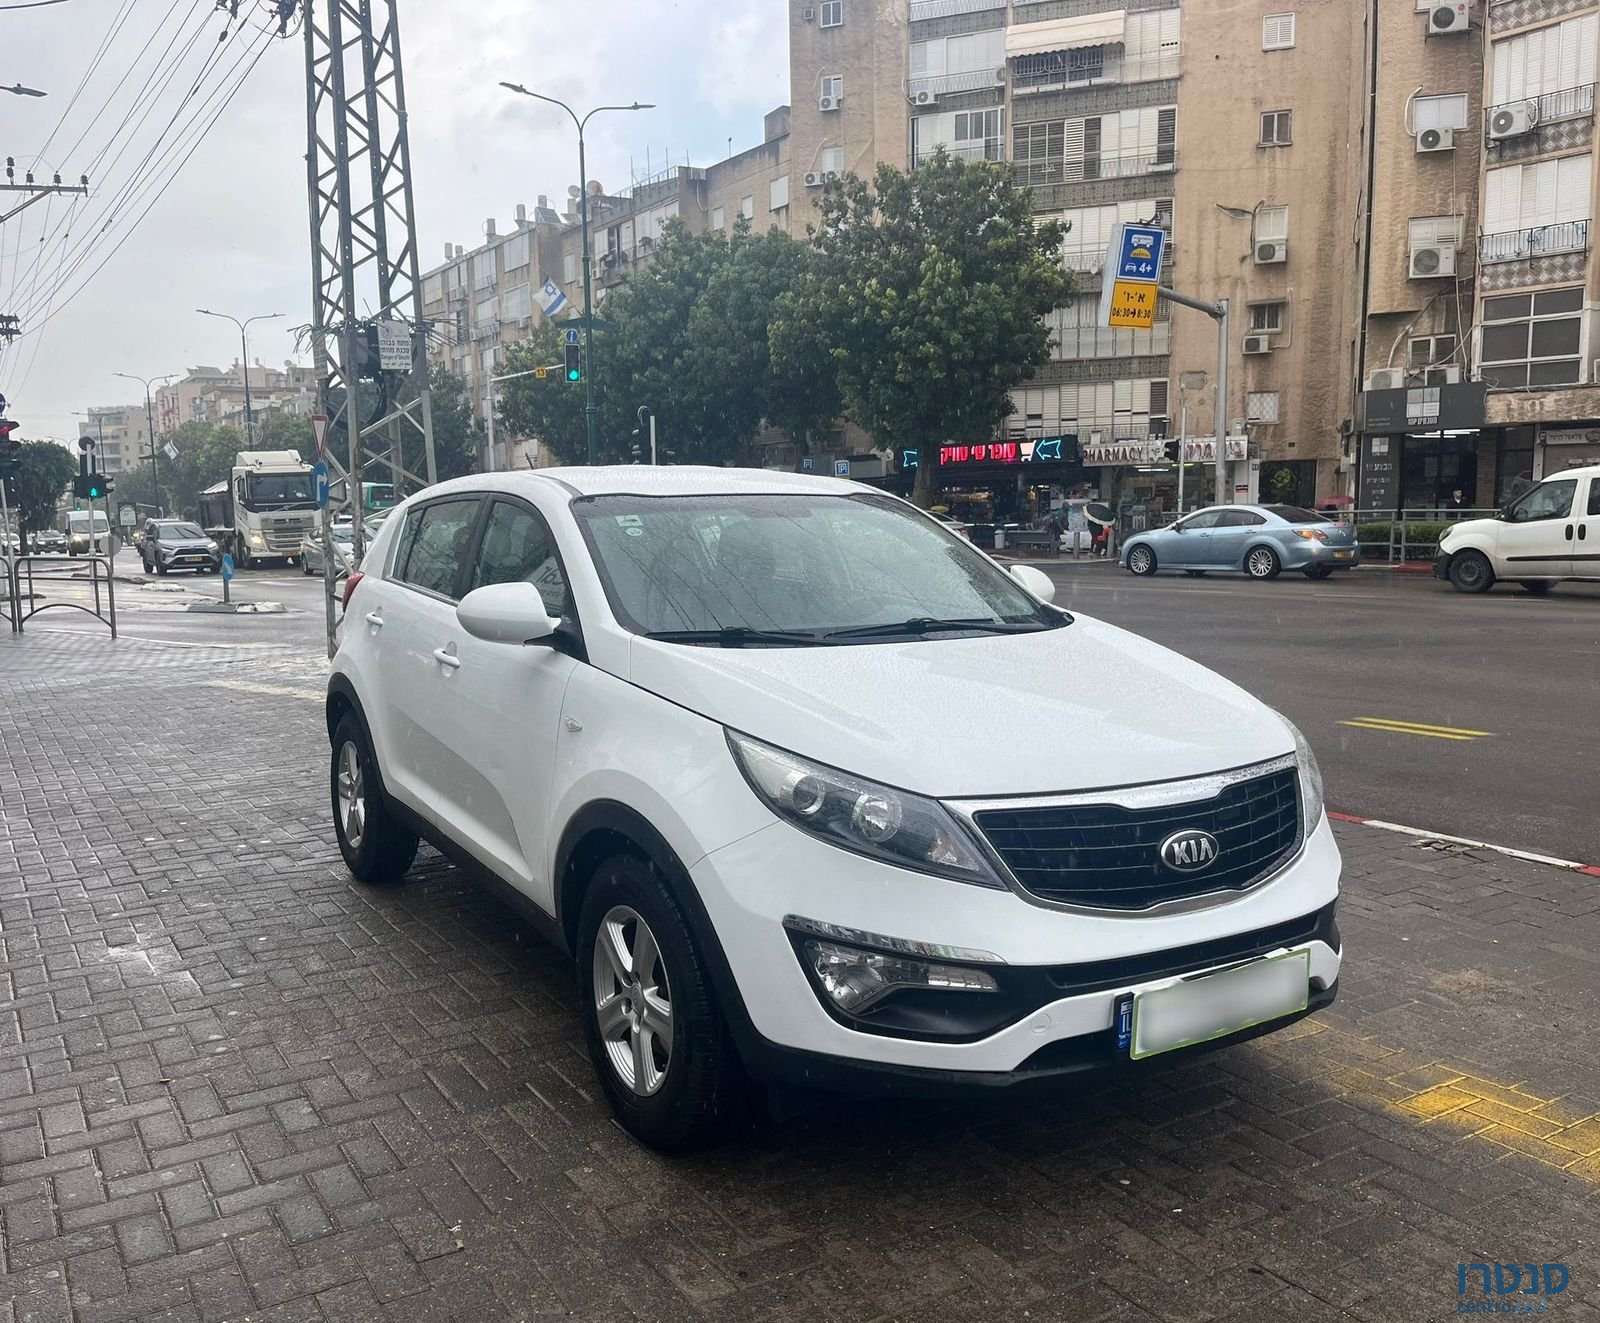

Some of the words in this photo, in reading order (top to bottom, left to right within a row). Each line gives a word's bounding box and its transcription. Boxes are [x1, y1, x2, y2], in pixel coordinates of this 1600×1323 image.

[1139, 262, 1152, 273] 4+
[988, 442, 1016, 459] סופר
[1083, 447, 1144, 463] PHARMACY
[1172, 837, 1213, 864] KIA
